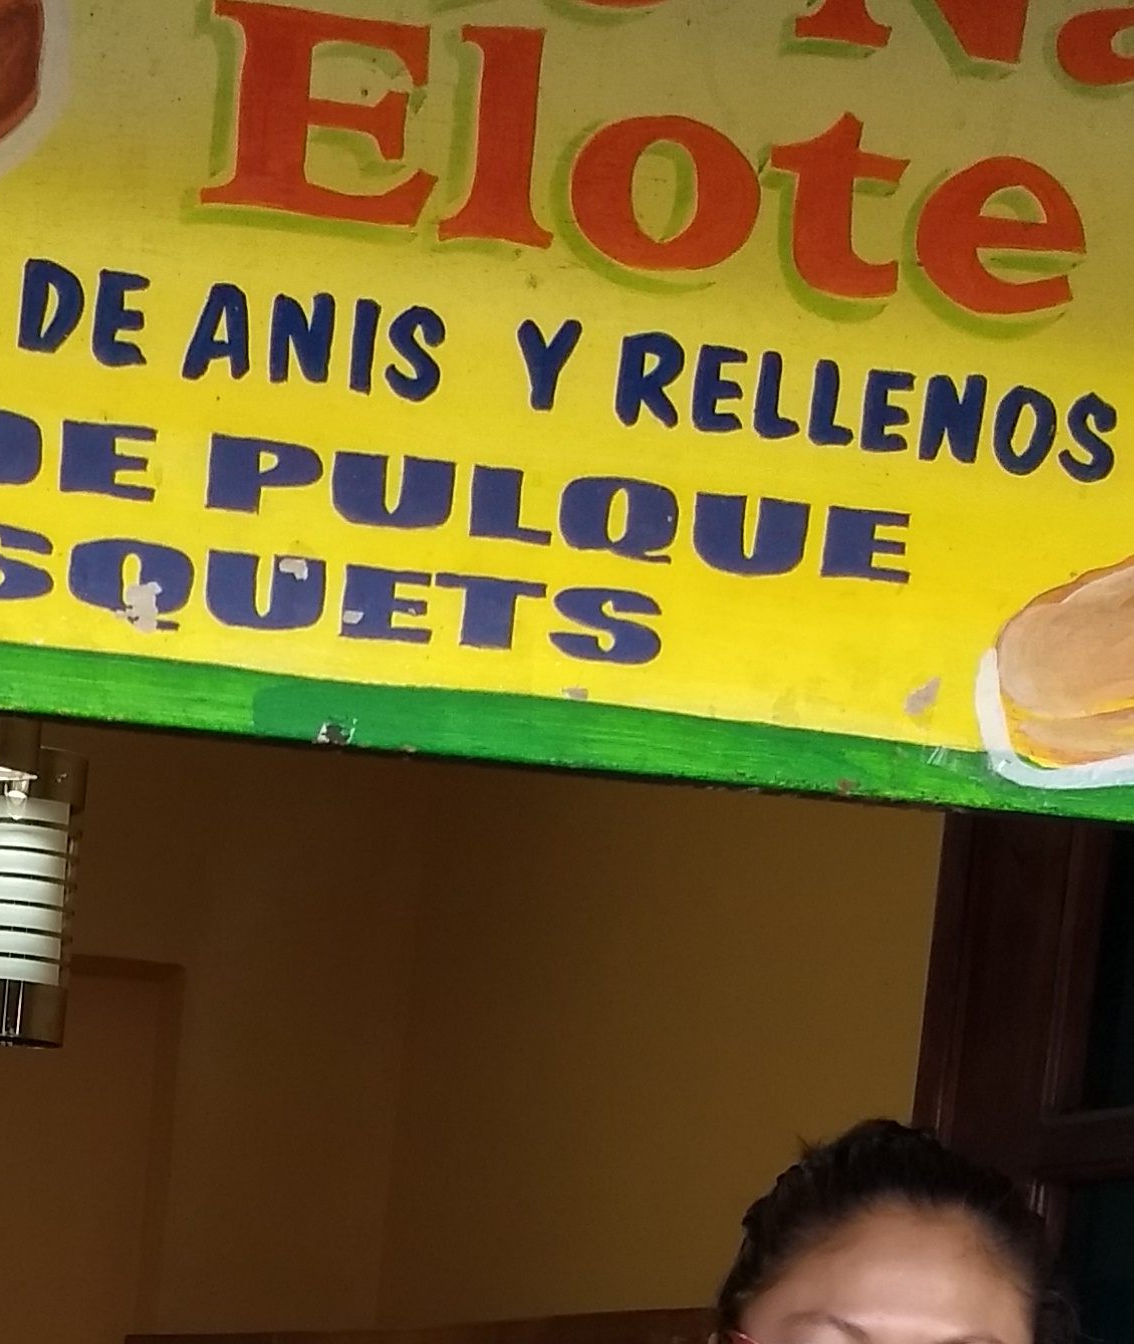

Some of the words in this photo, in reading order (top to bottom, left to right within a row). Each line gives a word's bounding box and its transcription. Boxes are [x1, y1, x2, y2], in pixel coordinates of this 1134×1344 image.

[200, 0, 1087, 316] Elote
[17, 258, 150, 367] DE
[182, 283, 446, 401] ANIS
[516, 319, 582, 411] Y
[615, 331, 1117, 482] RELLENOS
[205, 433, 911, 583] PULQUE
